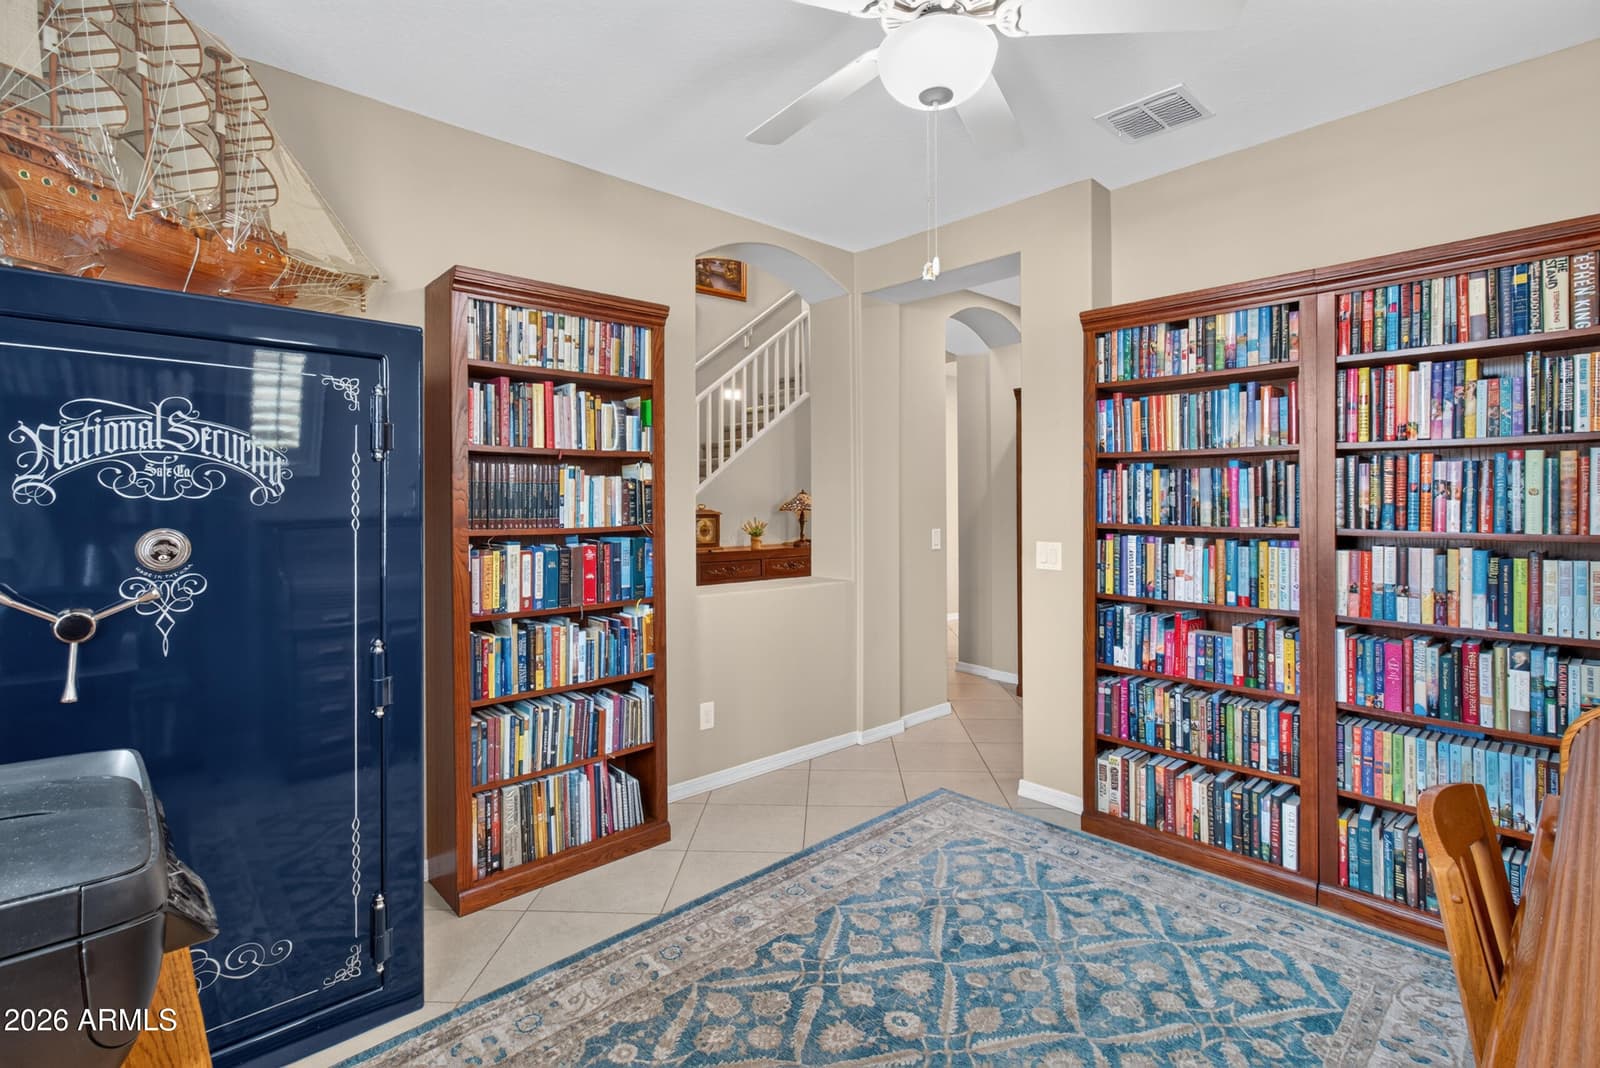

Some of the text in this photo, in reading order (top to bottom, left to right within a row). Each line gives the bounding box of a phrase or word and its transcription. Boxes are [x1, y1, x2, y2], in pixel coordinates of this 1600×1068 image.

[1545, 259, 1558, 290] STAND
[1557, 257, 1568, 273] THE
[1574, 299, 1592, 329] KING
[9, 400, 288, 497] National Security
[135, 566, 153, 578] MADE
